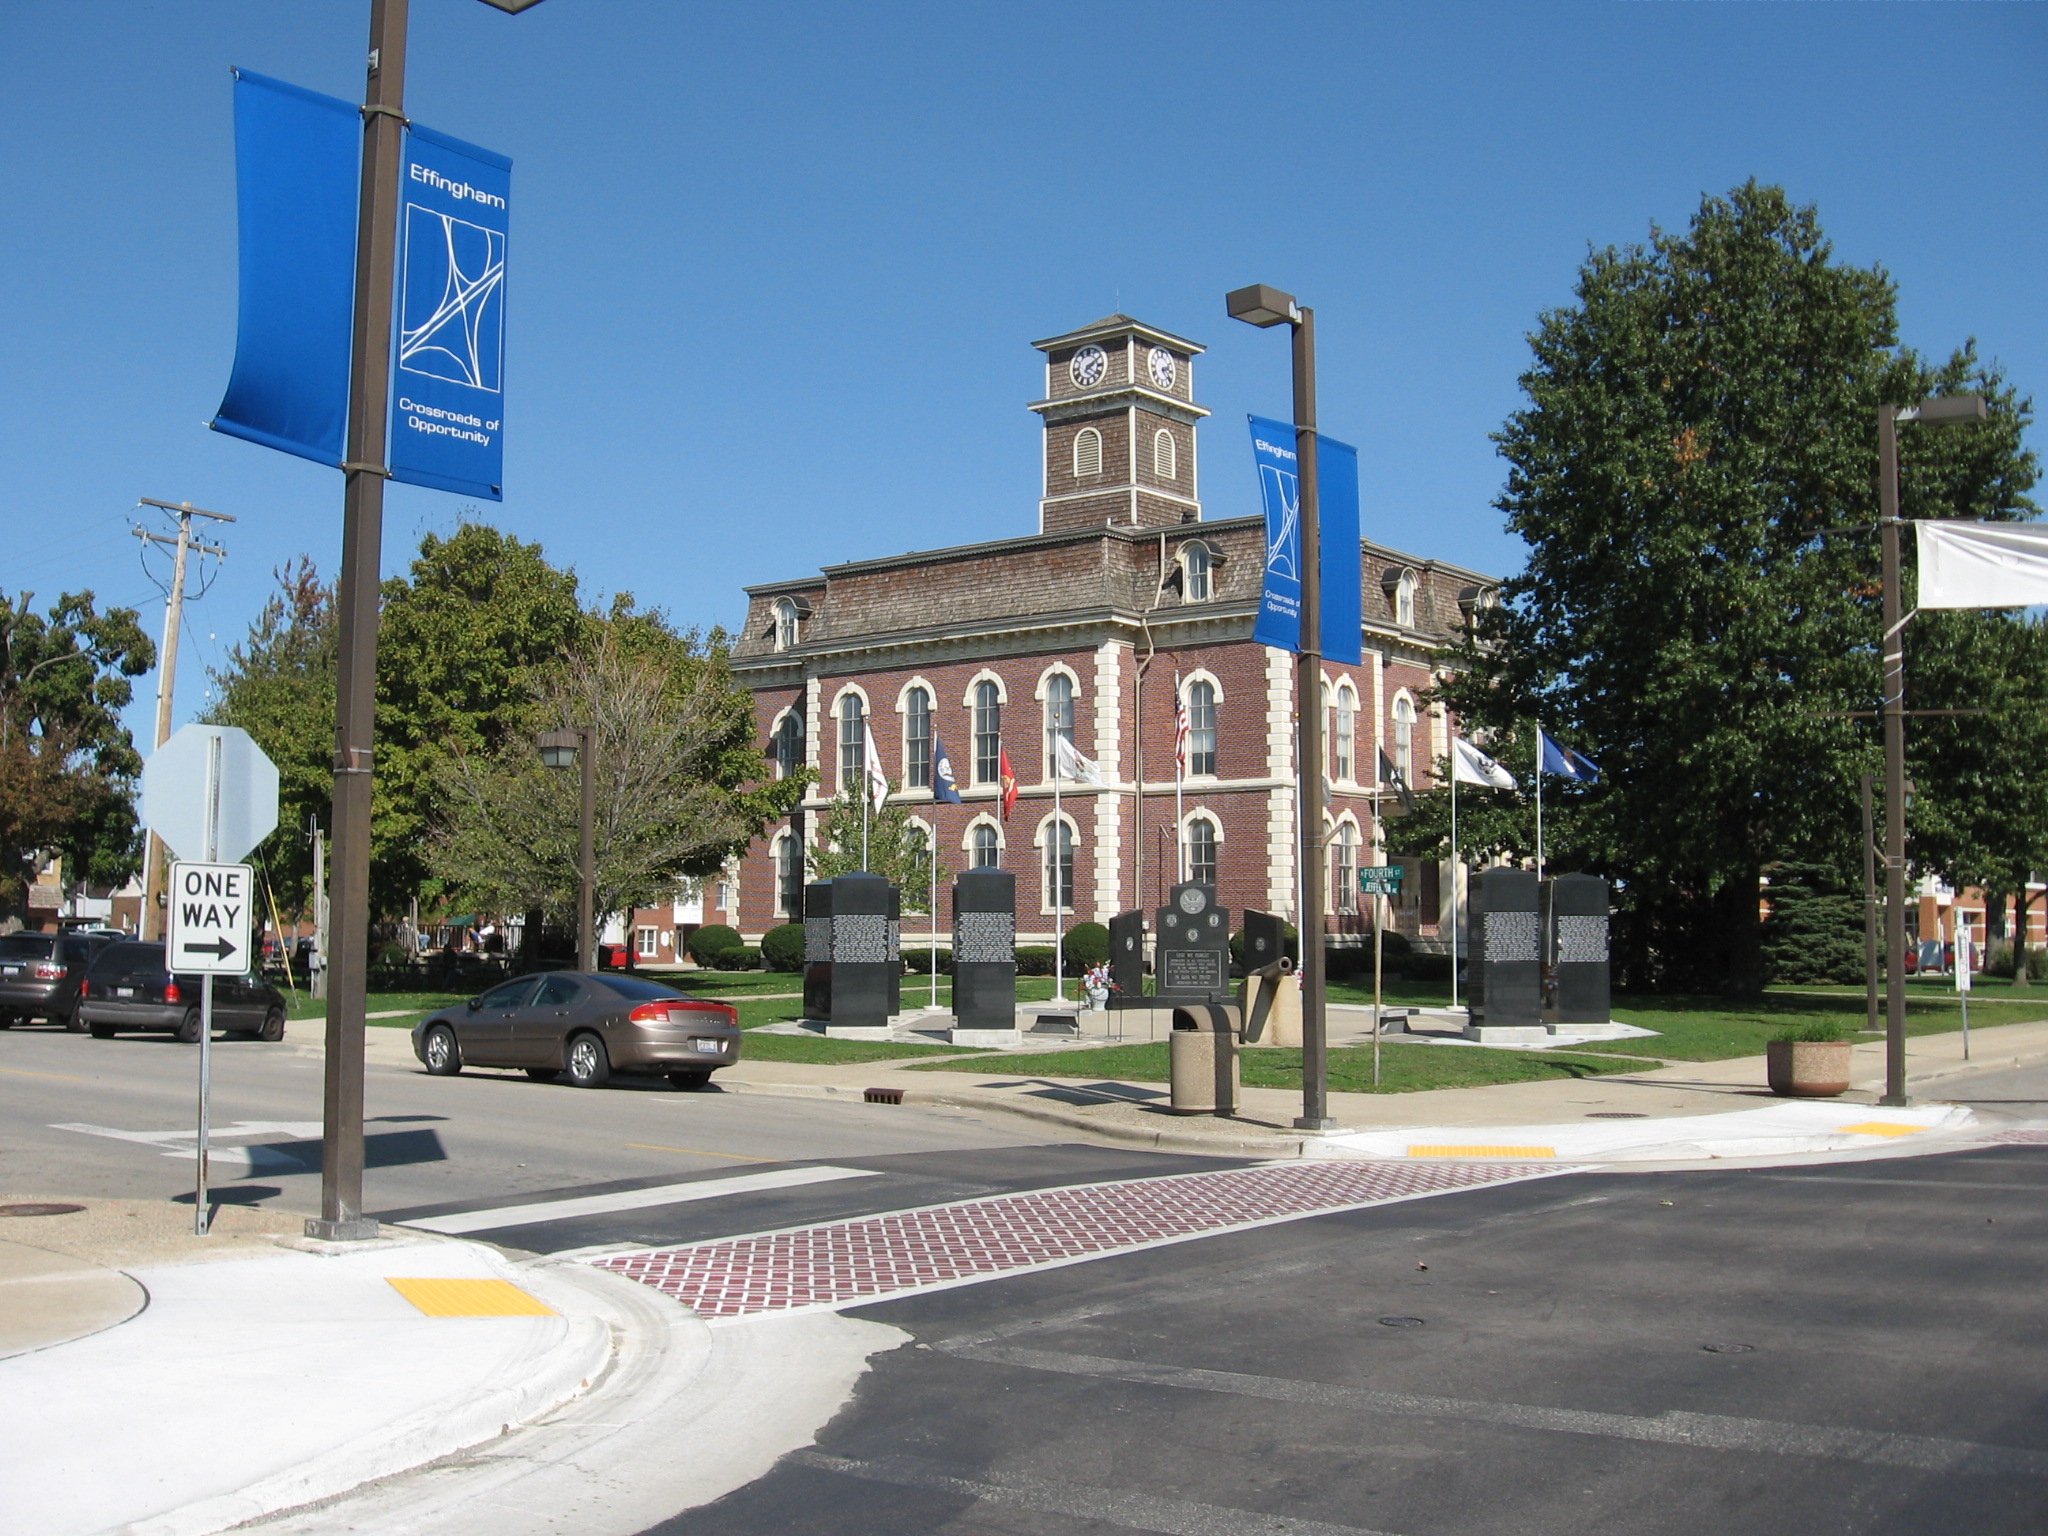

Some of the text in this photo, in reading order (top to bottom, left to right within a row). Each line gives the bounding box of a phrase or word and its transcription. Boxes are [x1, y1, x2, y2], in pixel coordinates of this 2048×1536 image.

[410, 162, 506, 210] Effingham
[399, 397, 500, 431] Crossroads of
[408, 415, 490, 447] Opportunity
[1255, 438, 1297, 461] Effingham
[185, 871, 240, 898] ONE
[1363, 868, 1394, 879] FOURTH
[182, 903, 241, 929] WAY
